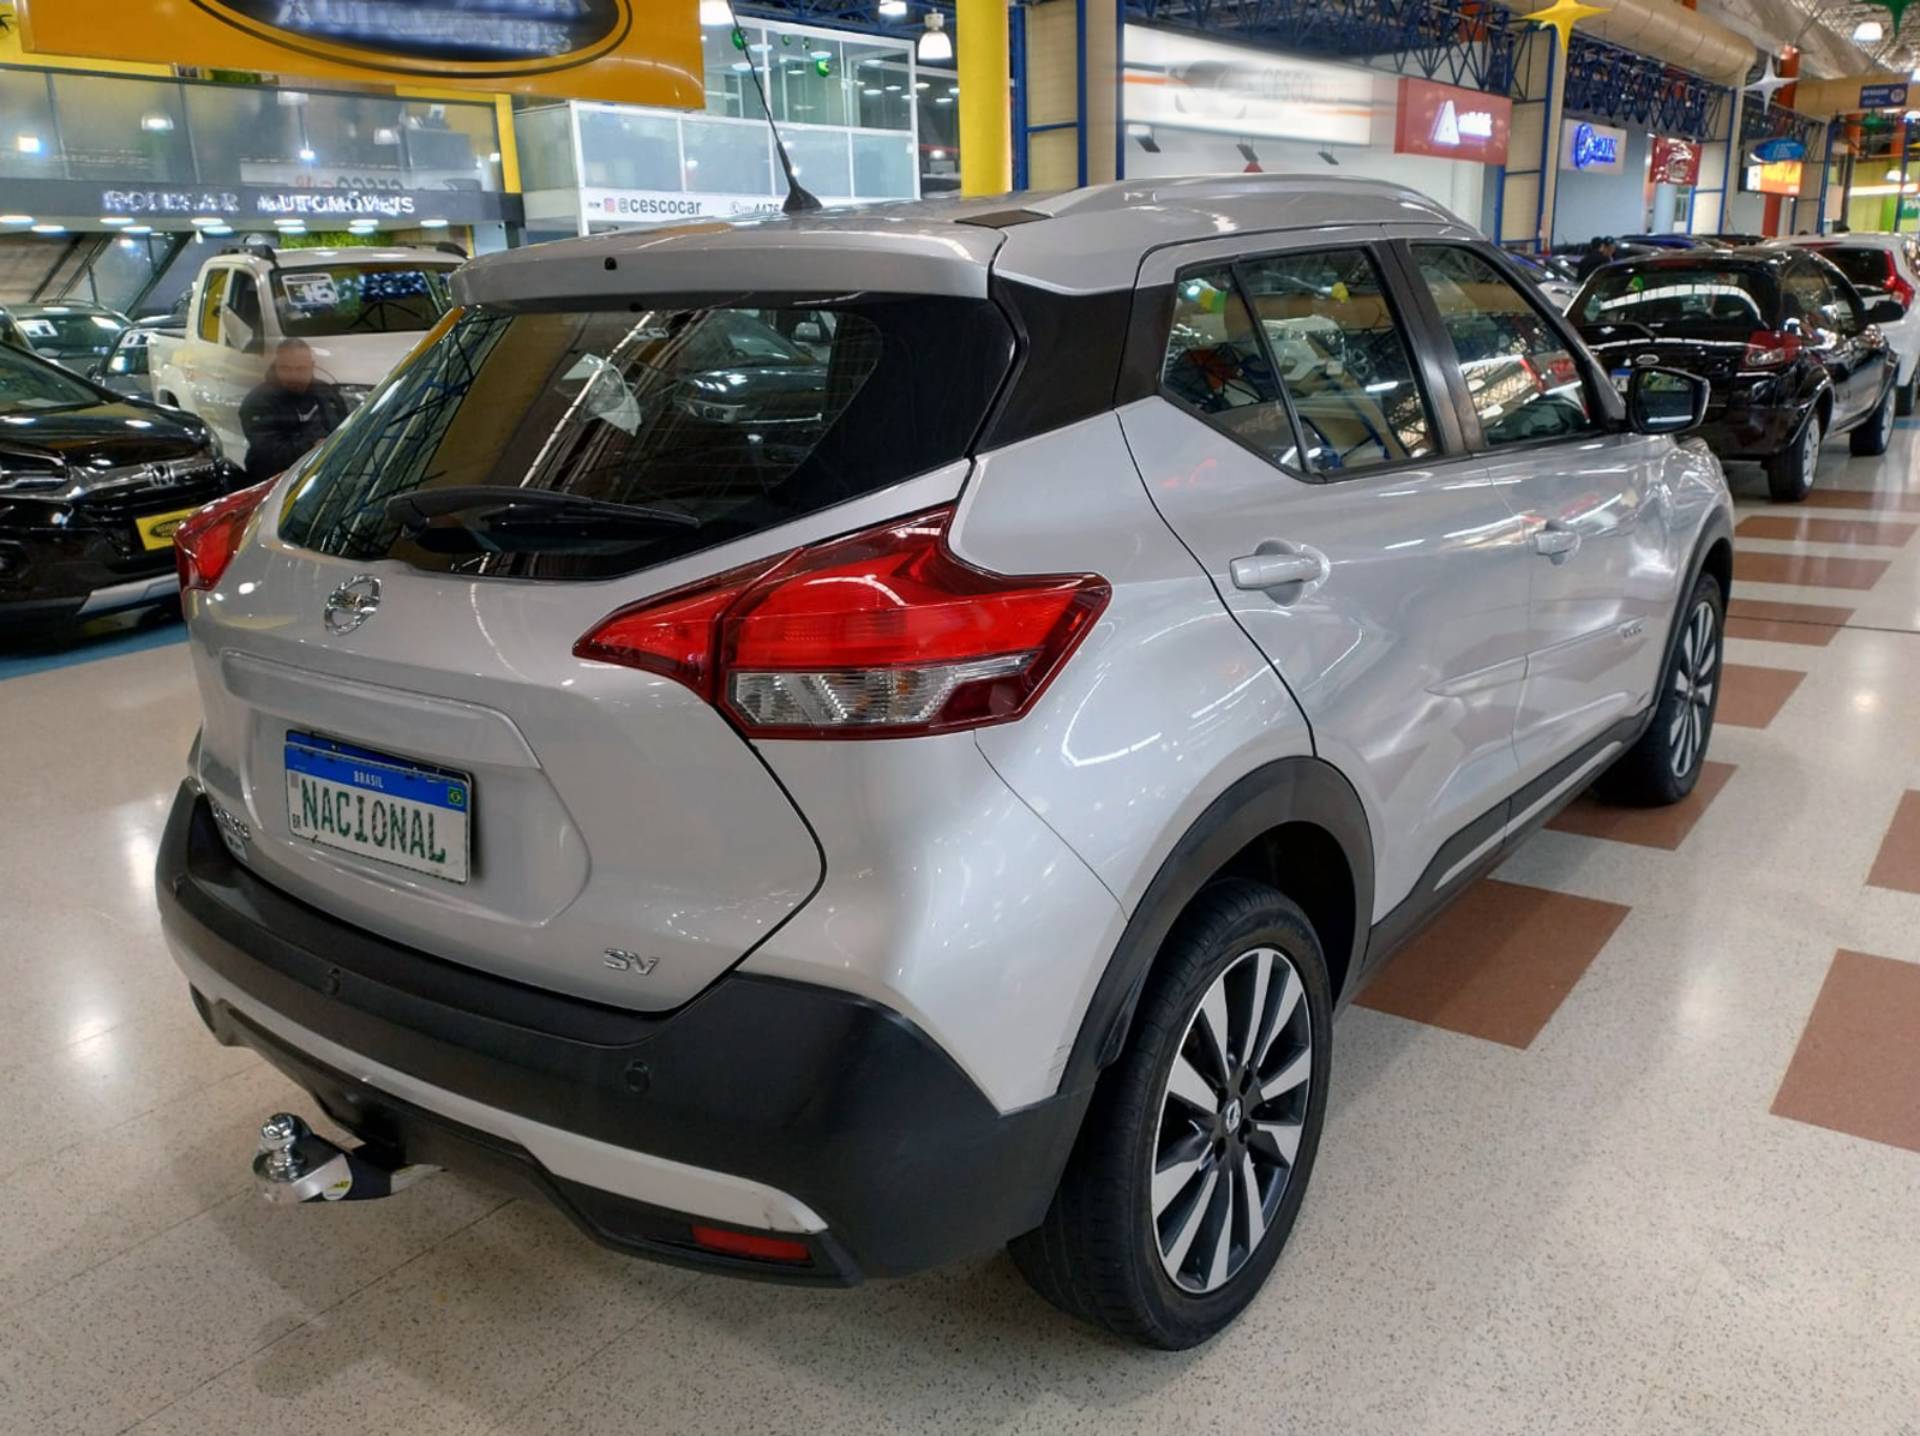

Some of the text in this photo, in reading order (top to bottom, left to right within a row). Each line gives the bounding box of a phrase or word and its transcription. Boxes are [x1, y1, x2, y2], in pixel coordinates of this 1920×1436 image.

[618, 198, 702, 215] @cescocar
[353, 770, 384, 789] BRASIL
[301, 778, 446, 864] NACIONAL
[603, 948, 660, 976] SV
